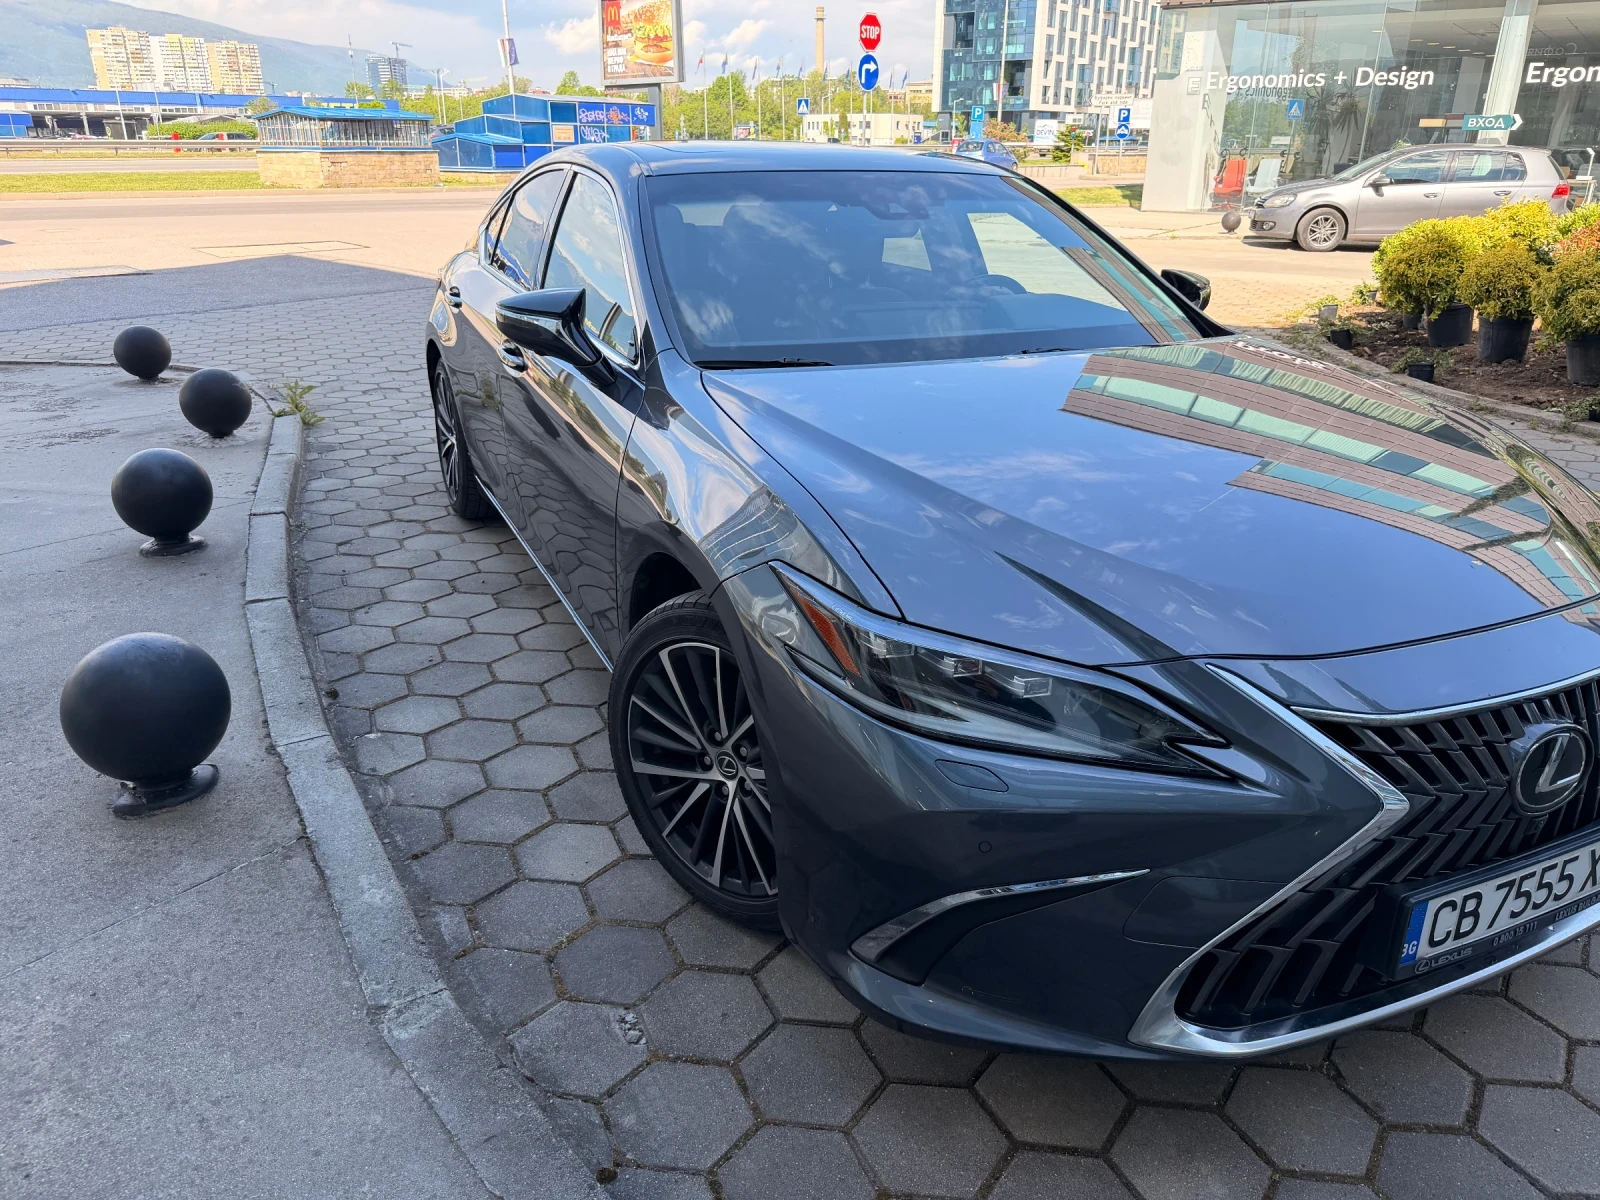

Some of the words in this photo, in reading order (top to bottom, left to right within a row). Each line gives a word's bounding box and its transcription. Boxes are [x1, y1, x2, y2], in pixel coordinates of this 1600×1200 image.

[861, 25, 880, 40] STOP
[1206, 68, 1326, 93] Ergonomics
[1334, 70, 1347, 85] +
[1355, 65, 1435, 90] Design
[1525, 61, 1600, 88] Ergon
[974, 108, 982, 119] P
[1120, 110, 1129, 121] P
[1467, 118, 1505, 129] ВХОД
[1428, 890, 1483, 948] CB
[1486, 855, 1580, 930] 7555
[1578, 849, 1600, 893] X
[1554, 905, 1578, 921] LEXUS
[1493, 936, 1499, 947] 0
[1499, 930, 1514, 944] 800
[1525, 920, 1538, 933] 111
[1430, 946, 1473, 967] LEXUS
